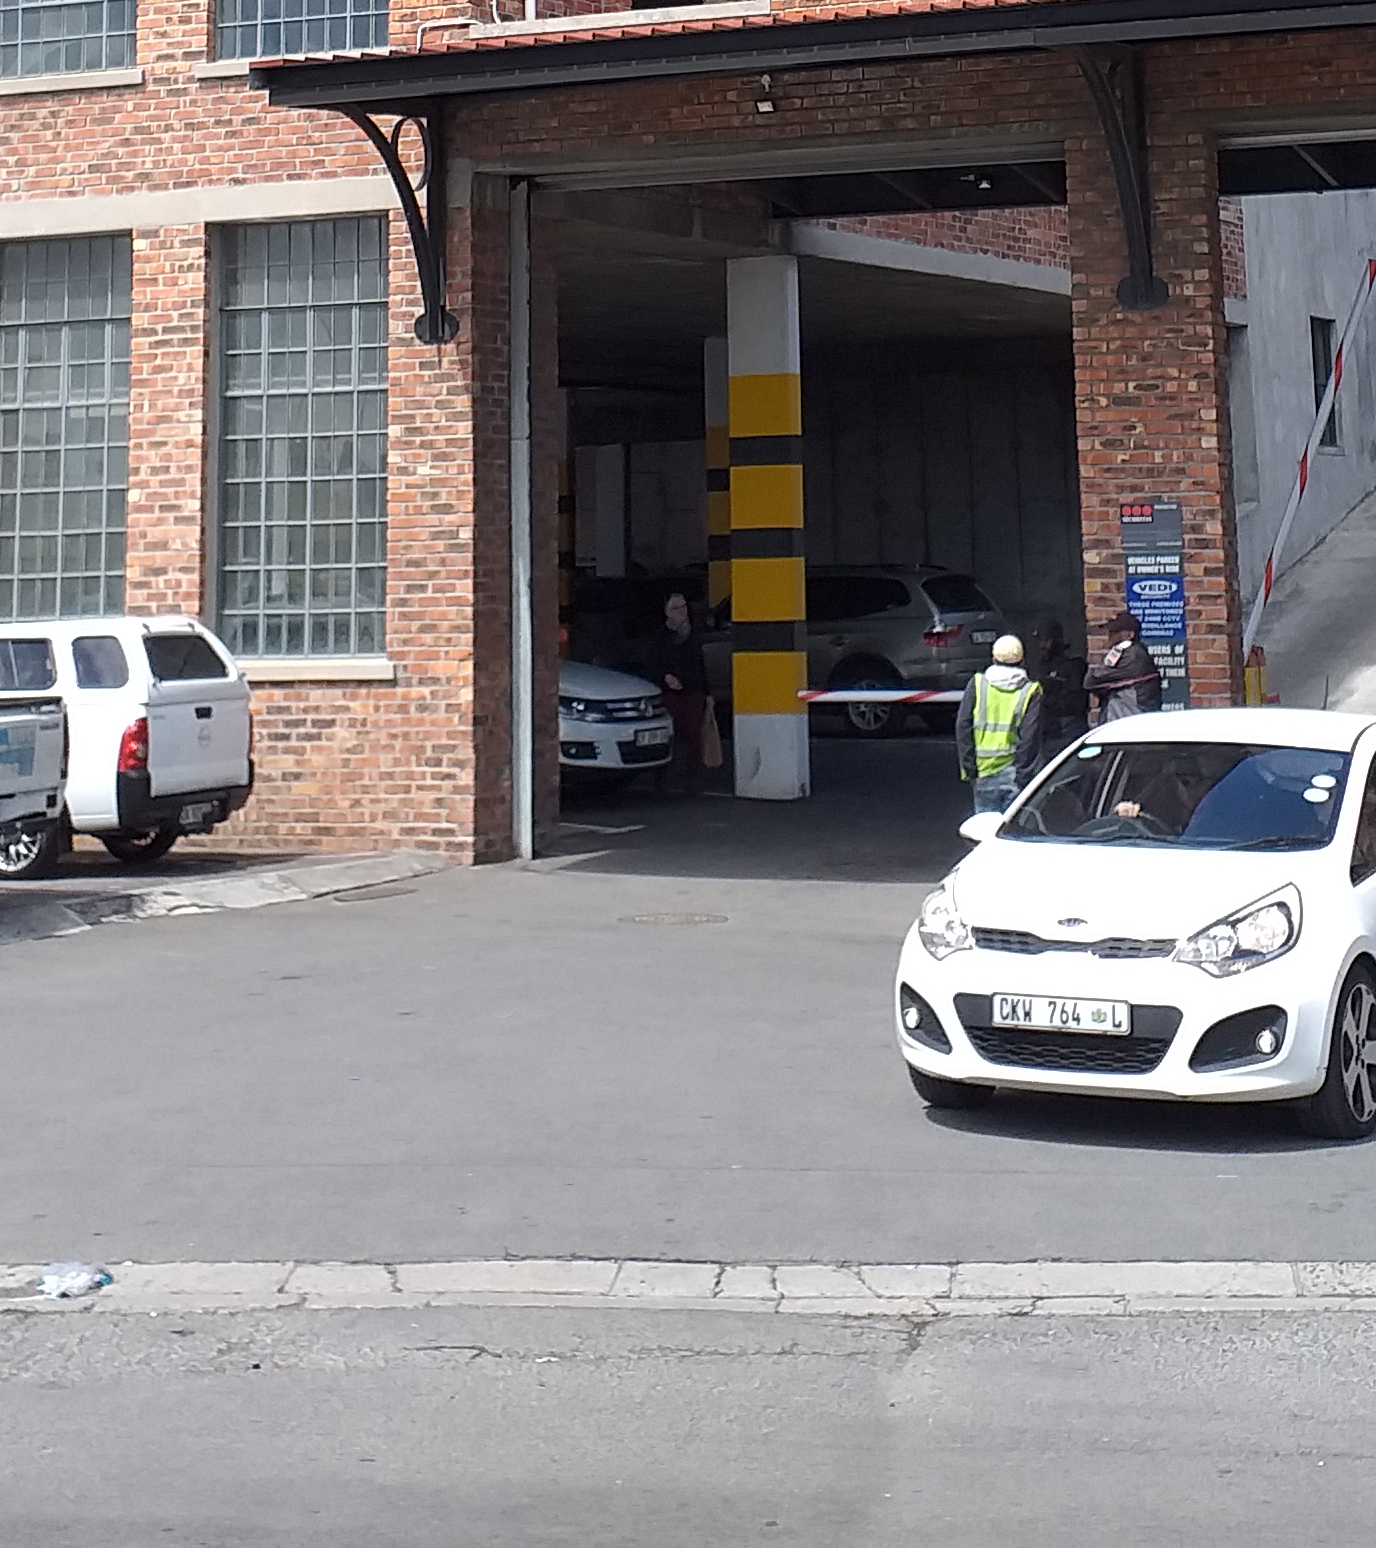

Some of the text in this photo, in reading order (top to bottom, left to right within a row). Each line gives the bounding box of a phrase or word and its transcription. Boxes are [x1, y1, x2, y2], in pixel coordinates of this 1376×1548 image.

[1138, 583, 1172, 592] VEDI
[1048, 1001, 1081, 1026] 764
[1112, 1004, 1122, 1028] L
